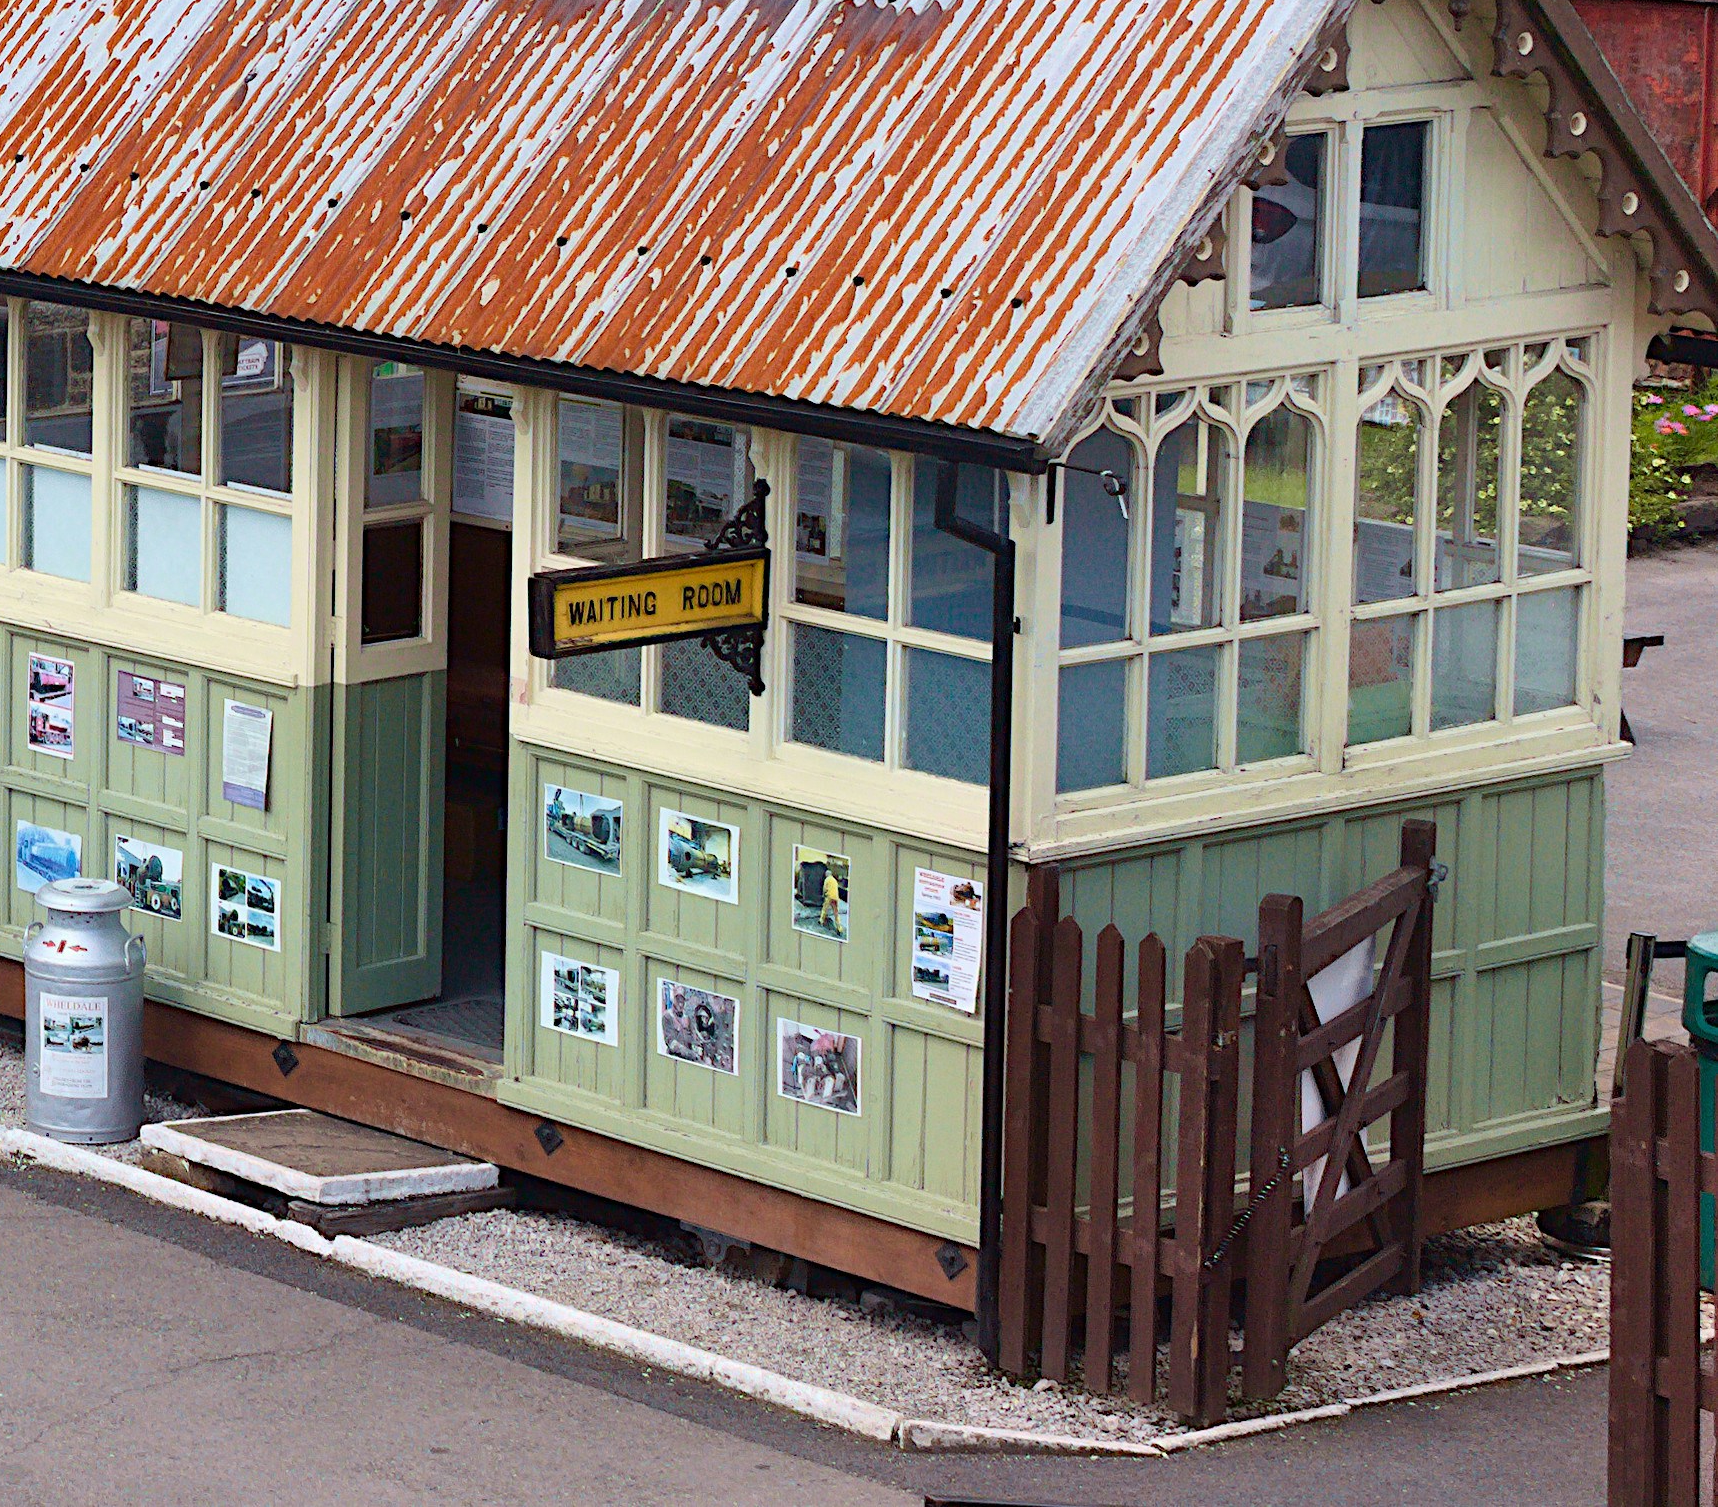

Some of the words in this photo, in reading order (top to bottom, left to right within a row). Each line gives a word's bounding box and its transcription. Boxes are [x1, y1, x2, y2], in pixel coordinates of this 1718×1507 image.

[568, 591, 657, 627] WAITING
[682, 578, 742, 612] ROOM
[45, 997, 101, 1012] WHELDALE
